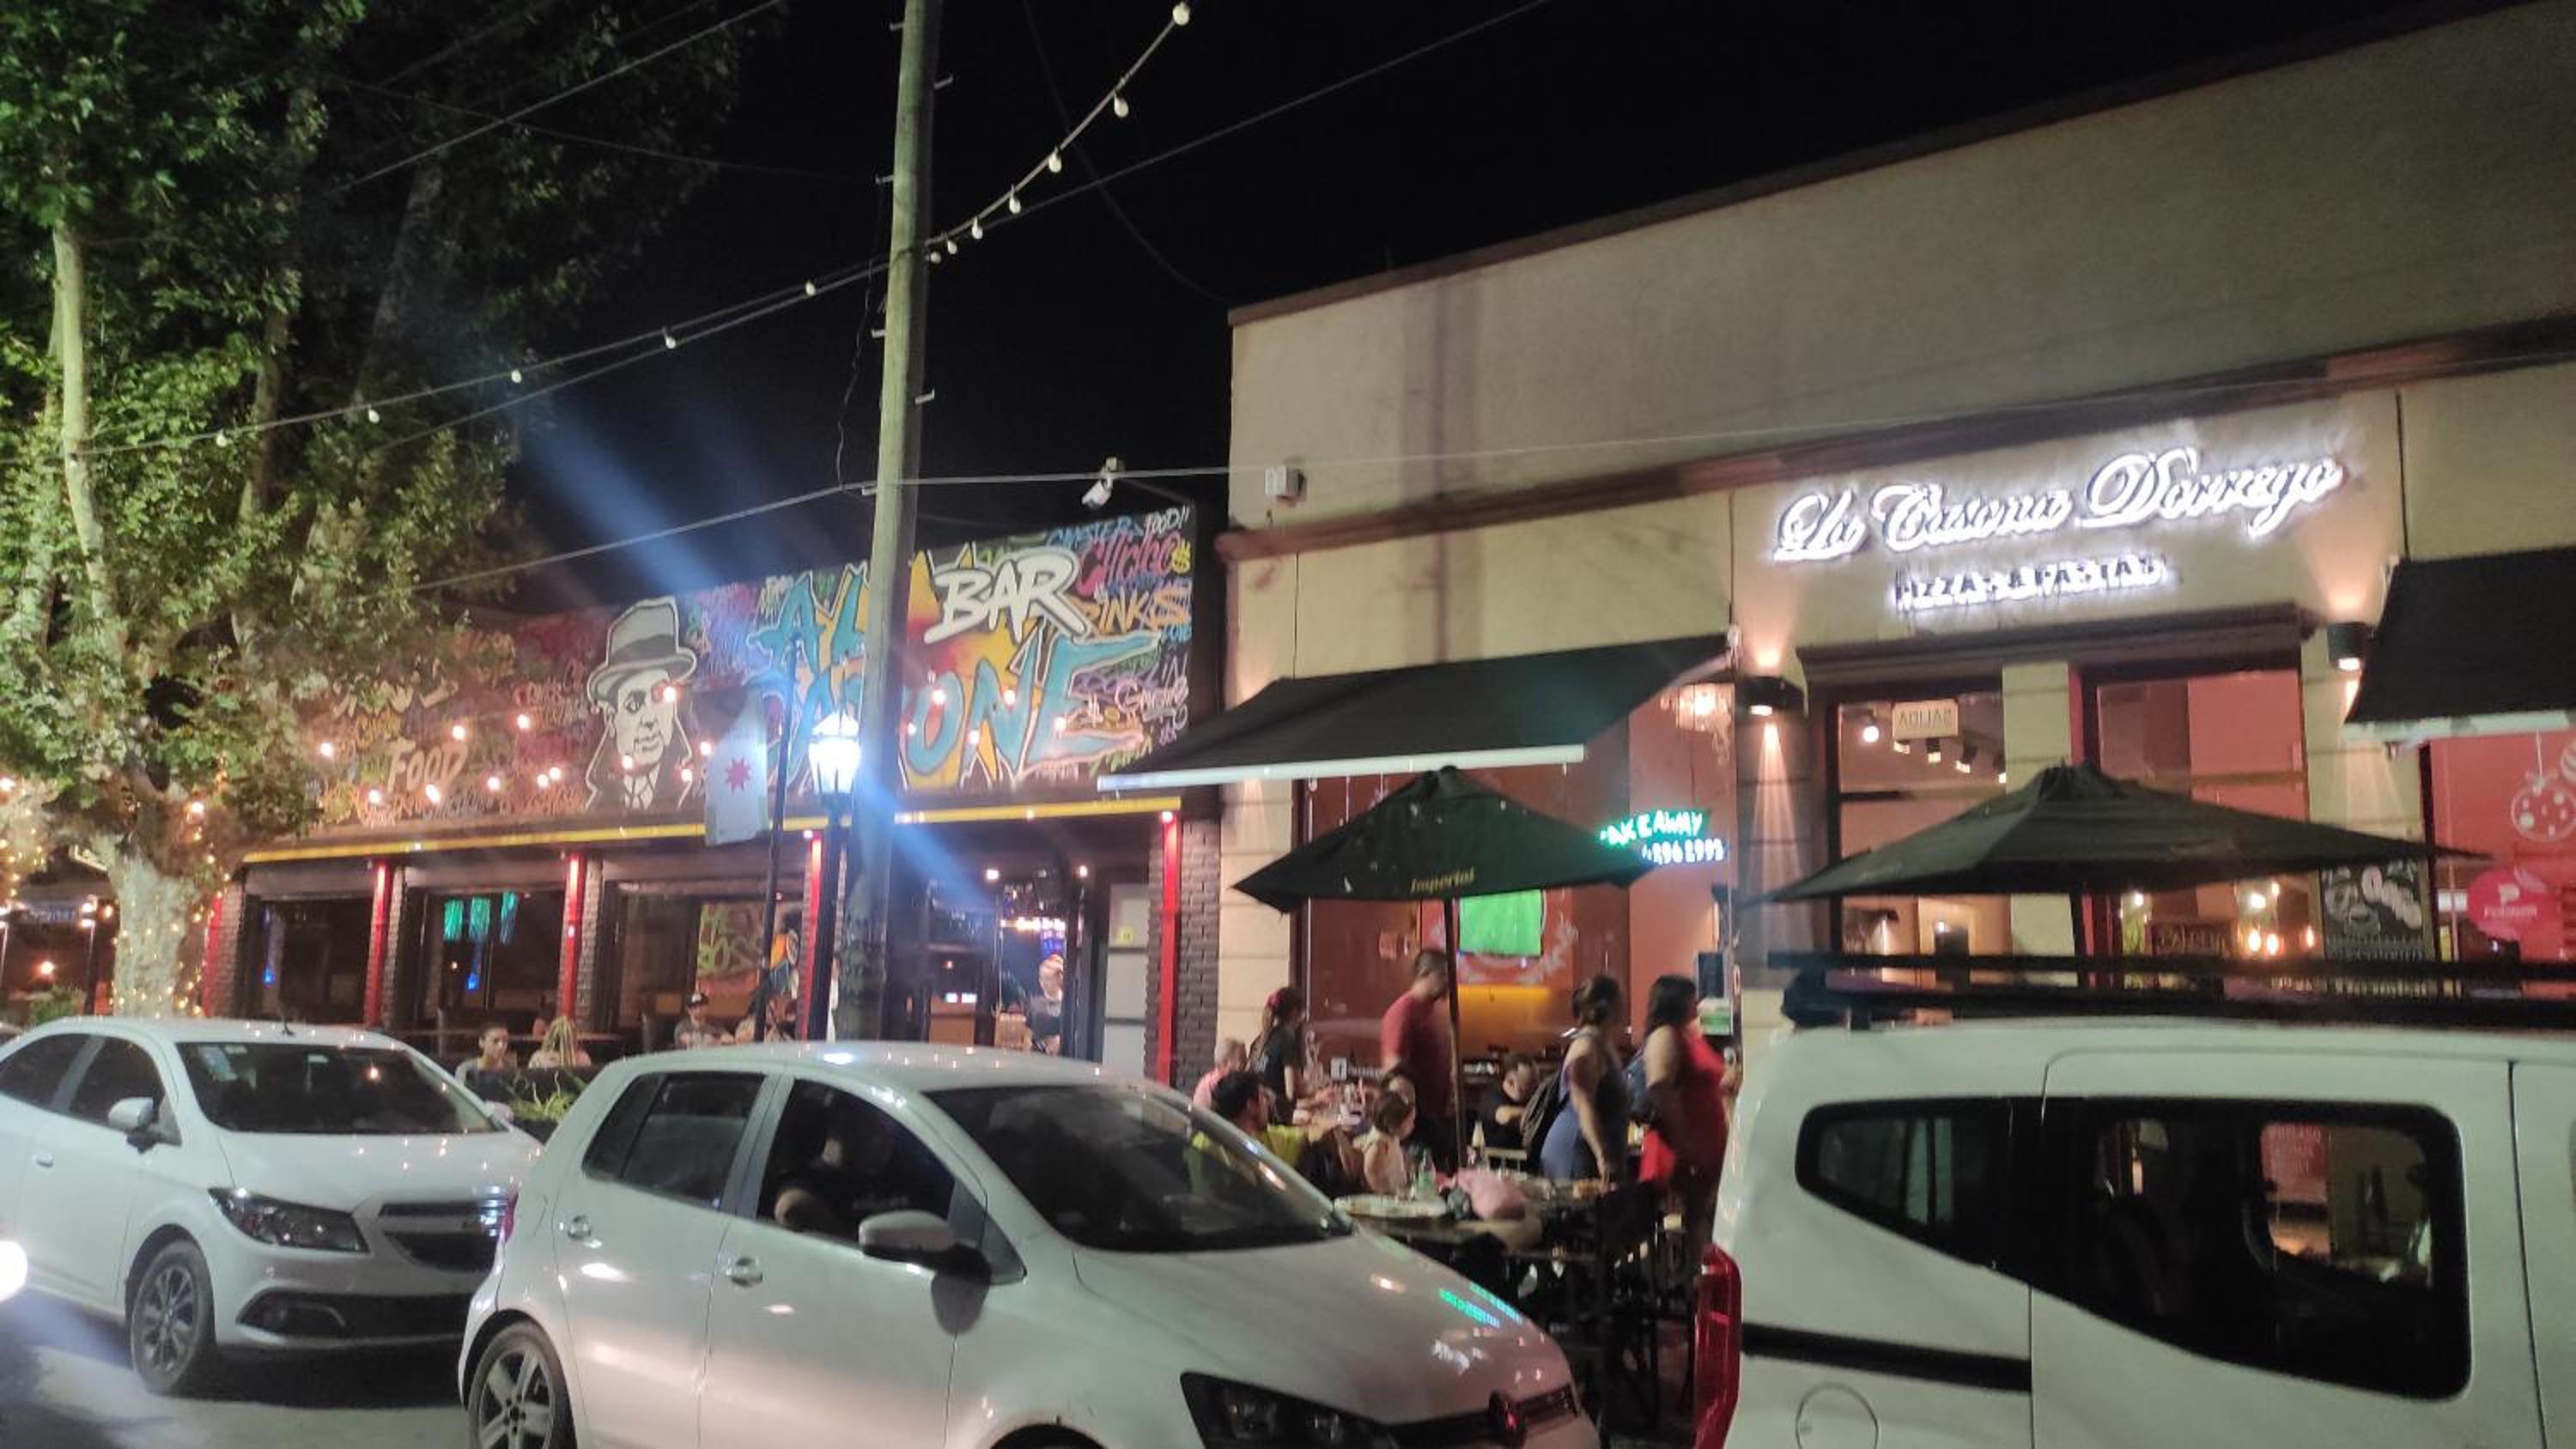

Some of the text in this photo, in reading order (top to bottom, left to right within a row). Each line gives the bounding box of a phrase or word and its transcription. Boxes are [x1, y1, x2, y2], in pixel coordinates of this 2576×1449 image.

[1774, 446, 2342, 560] La Casona Dorrego
[924, 544, 1091, 646] BAR
